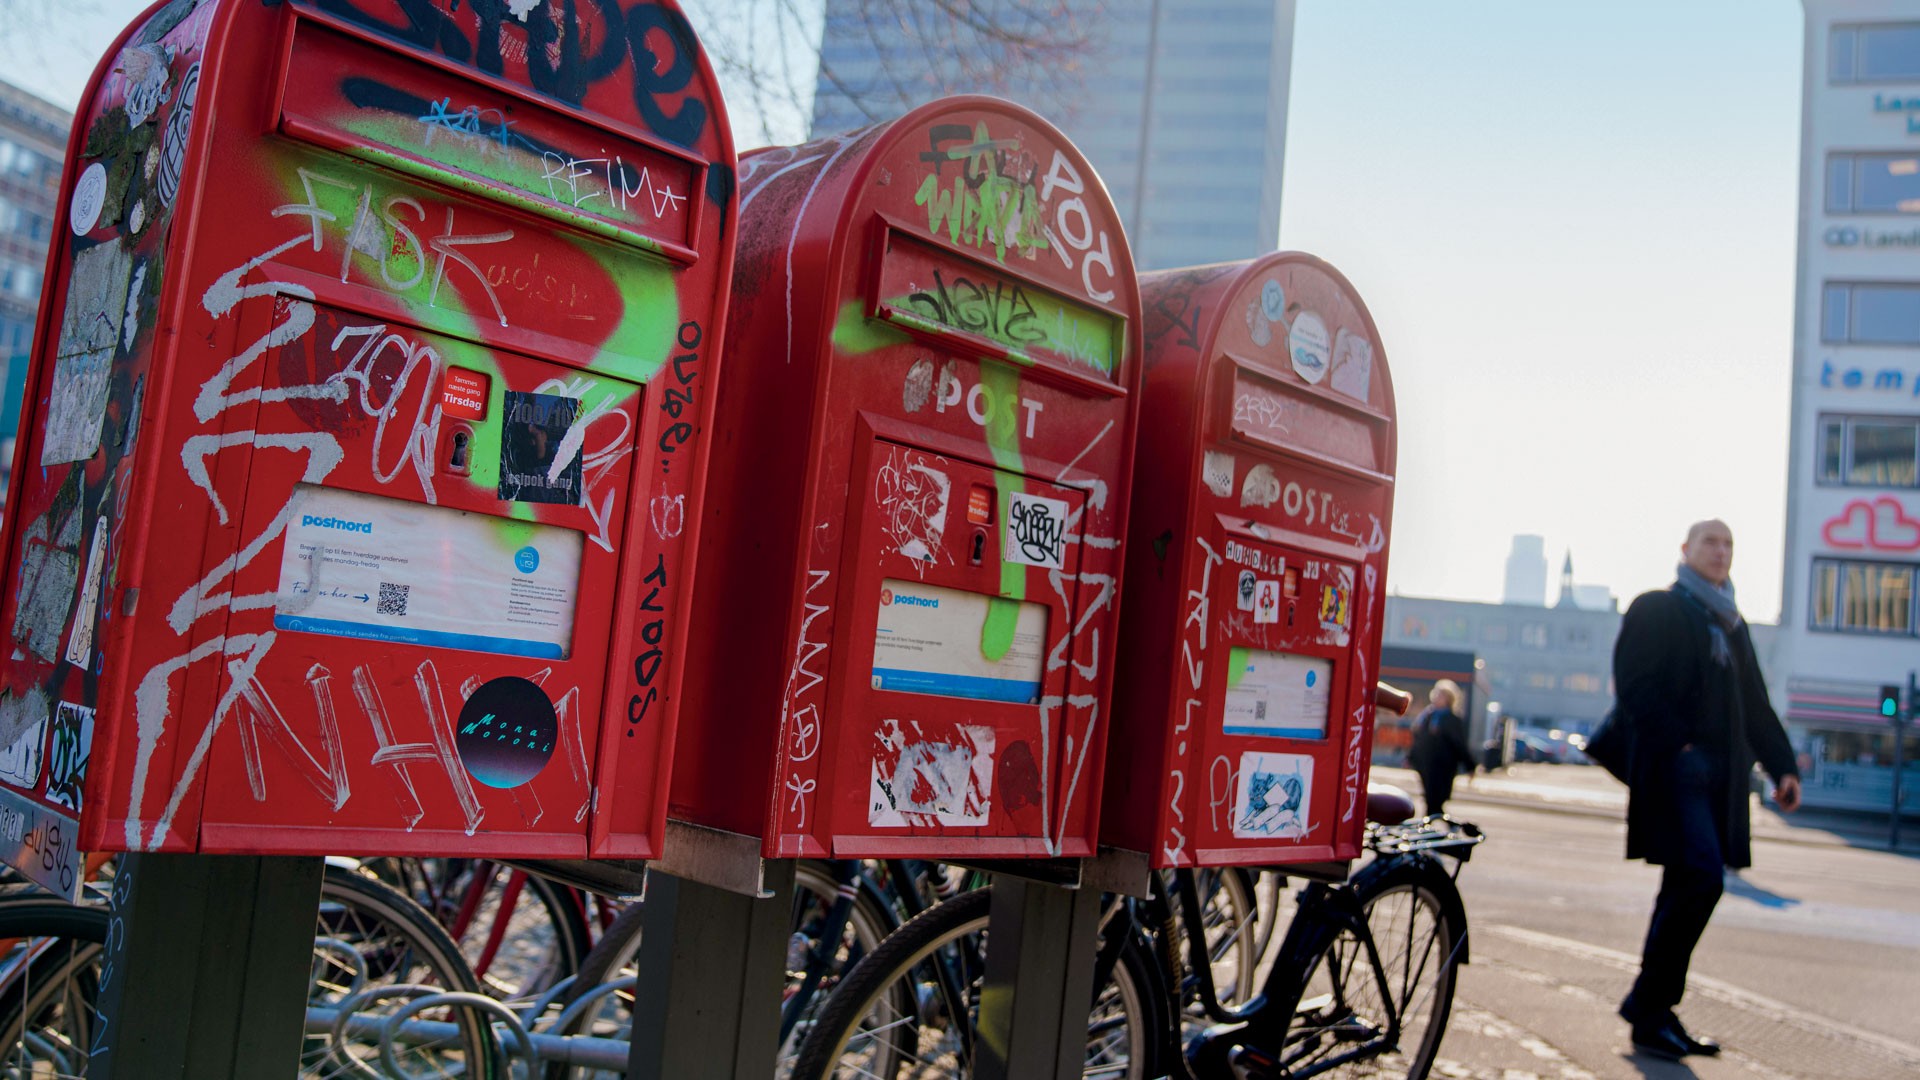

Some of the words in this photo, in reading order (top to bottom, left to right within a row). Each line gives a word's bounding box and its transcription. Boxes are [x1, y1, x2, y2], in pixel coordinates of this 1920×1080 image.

[443, 392, 482, 411] Tirsdag
[466, 388, 481, 397] gang
[935, 376, 1043, 439] POST
[1263, 474, 1333, 526] POST
[302, 514, 373, 534] postnord
[353, 551, 381, 560] hverdage
[894, 593, 939, 609] postnord
[478, 713, 538, 737] Mona
[460, 722, 550, 752] Moroni
